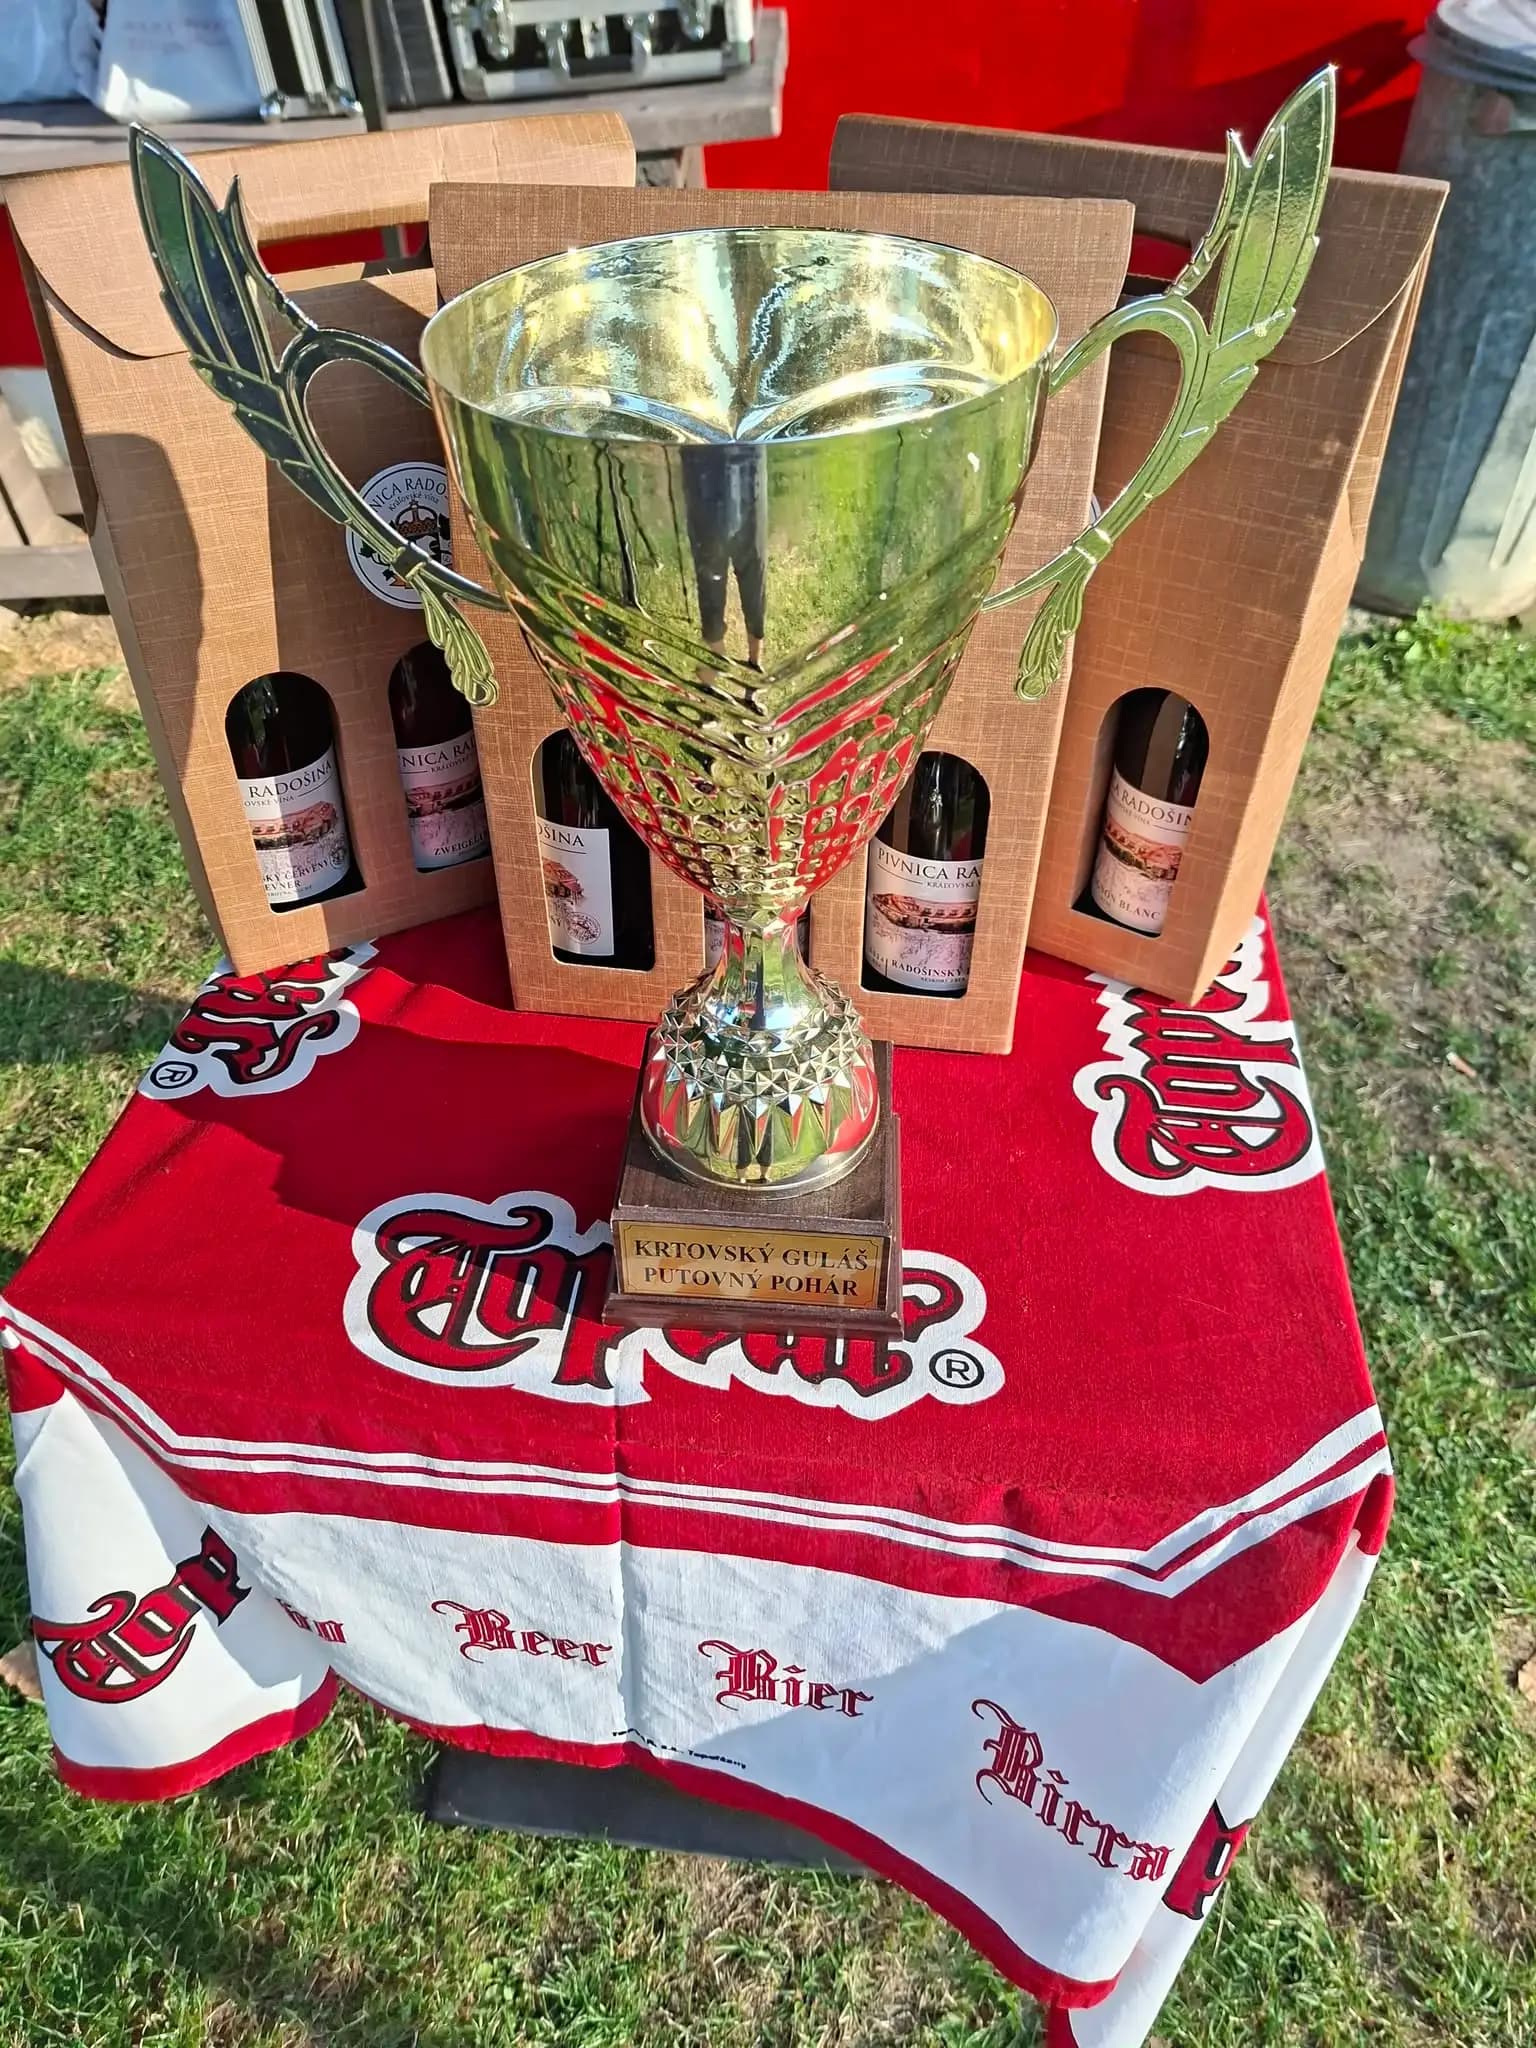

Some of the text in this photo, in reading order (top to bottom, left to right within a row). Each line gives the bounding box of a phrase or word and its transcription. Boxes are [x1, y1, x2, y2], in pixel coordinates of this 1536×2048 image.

[405, 478, 450, 498] RADO
[249, 760, 332, 798] RADOŠINA
[878, 847, 949, 880] PIVNICA
[1119, 900, 1161, 921] BLANC
[891, 958, 963, 978] RADOŠINSKÝ
[634, 1239, 869, 1272] KRTOVSKÝ GULÁŠ
[643, 1266, 858, 1298] PUTOVNÝ POHÁR
[431, 1599, 614, 1667] Beer
[697, 1639, 875, 1718] Bier
[971, 1698, 1175, 1881] Birra
